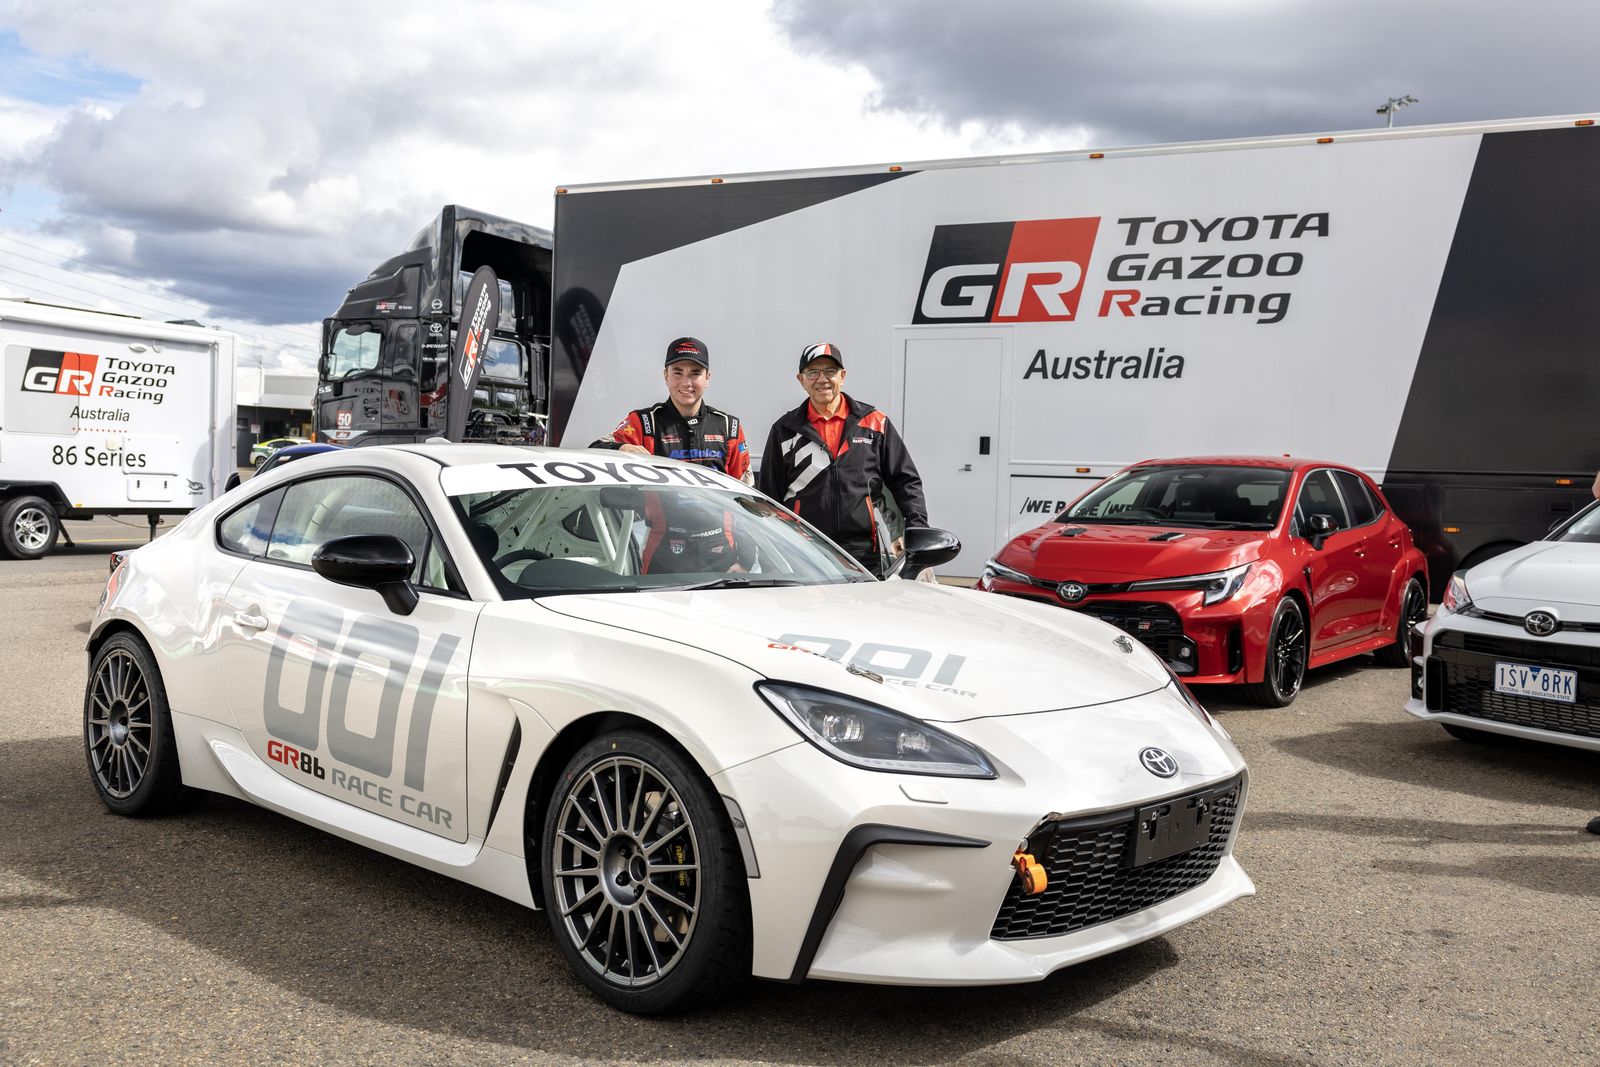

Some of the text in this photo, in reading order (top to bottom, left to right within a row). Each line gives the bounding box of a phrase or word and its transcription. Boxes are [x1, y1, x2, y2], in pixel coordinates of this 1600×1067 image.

[1117, 212, 1330, 246] TOYOTA
[1106, 252, 1304, 282] GAZOO
[920, 261, 1082, 319] GR
[1097, 286, 1292, 324] Racing
[105, 357, 175, 375] TOYOTA
[1022, 347, 1186, 380] Australia
[23, 366, 93, 395] GR
[102, 372, 168, 388] GAZOO
[98, 385, 164, 405] Racing
[70, 406, 130, 422] Australia
[337, 413, 352, 425] 50
[52, 445, 147, 468] 86 Series
[496, 461, 730, 489] TOYOTA
[925, 683, 978, 699] CAR
[1500, 667, 1573, 695] 1SV 8RK
[331, 768, 394, 808] RACE
[400, 794, 454, 829] CAR
